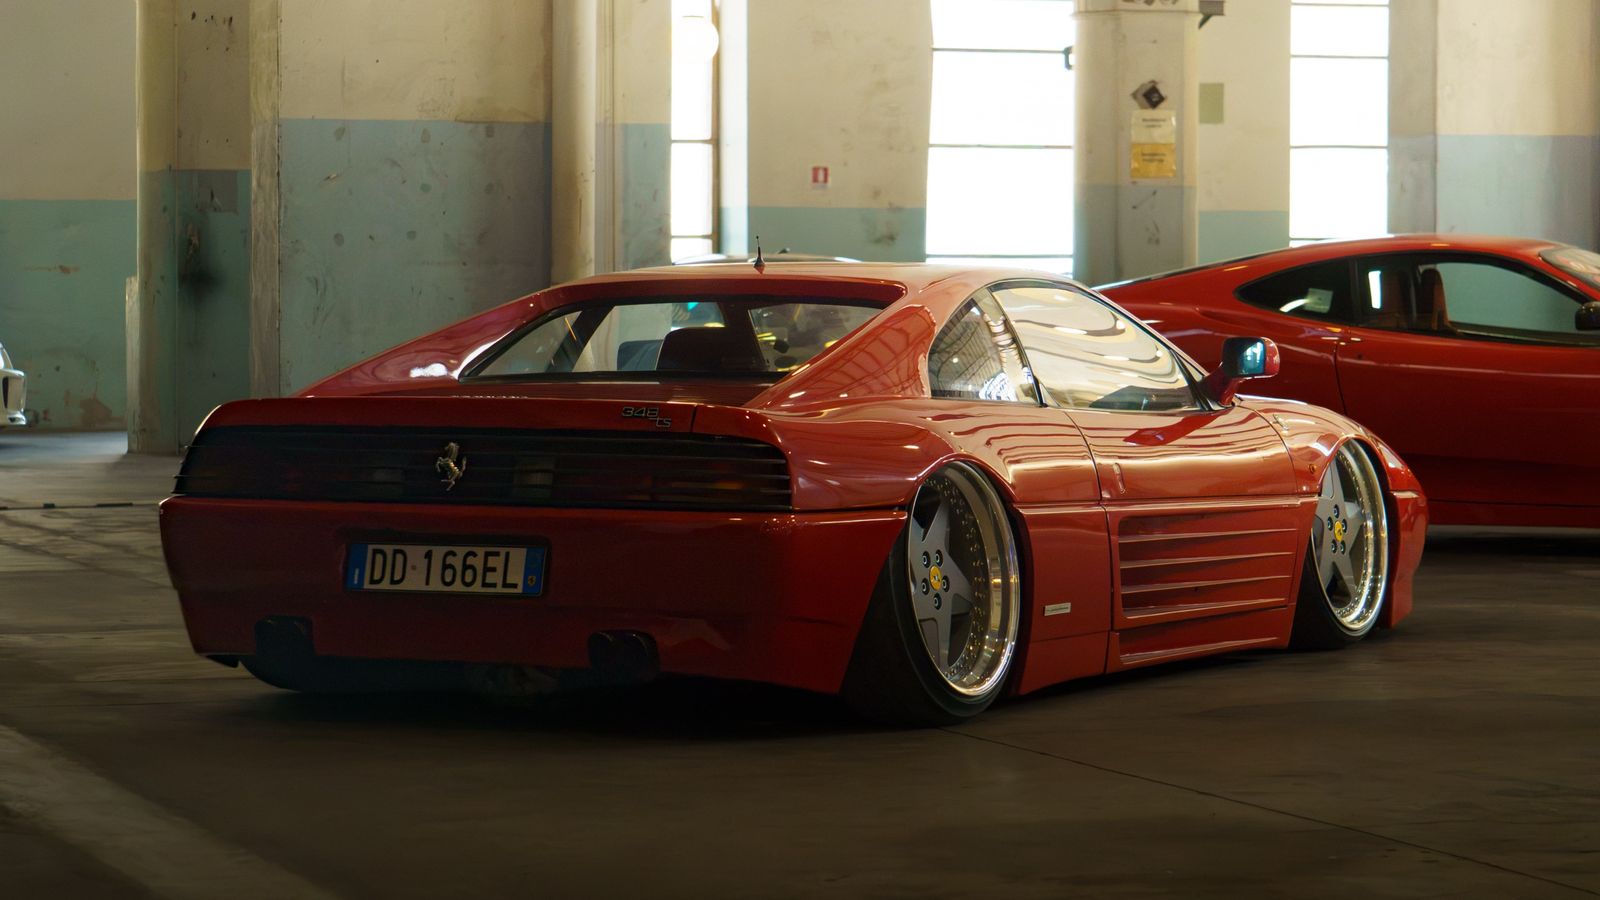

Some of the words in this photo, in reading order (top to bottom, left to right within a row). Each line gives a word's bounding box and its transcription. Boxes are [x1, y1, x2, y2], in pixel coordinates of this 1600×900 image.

[622, 406, 660, 418] 348
[369, 548, 407, 586] DD
[424, 549, 518, 590] 166EL
